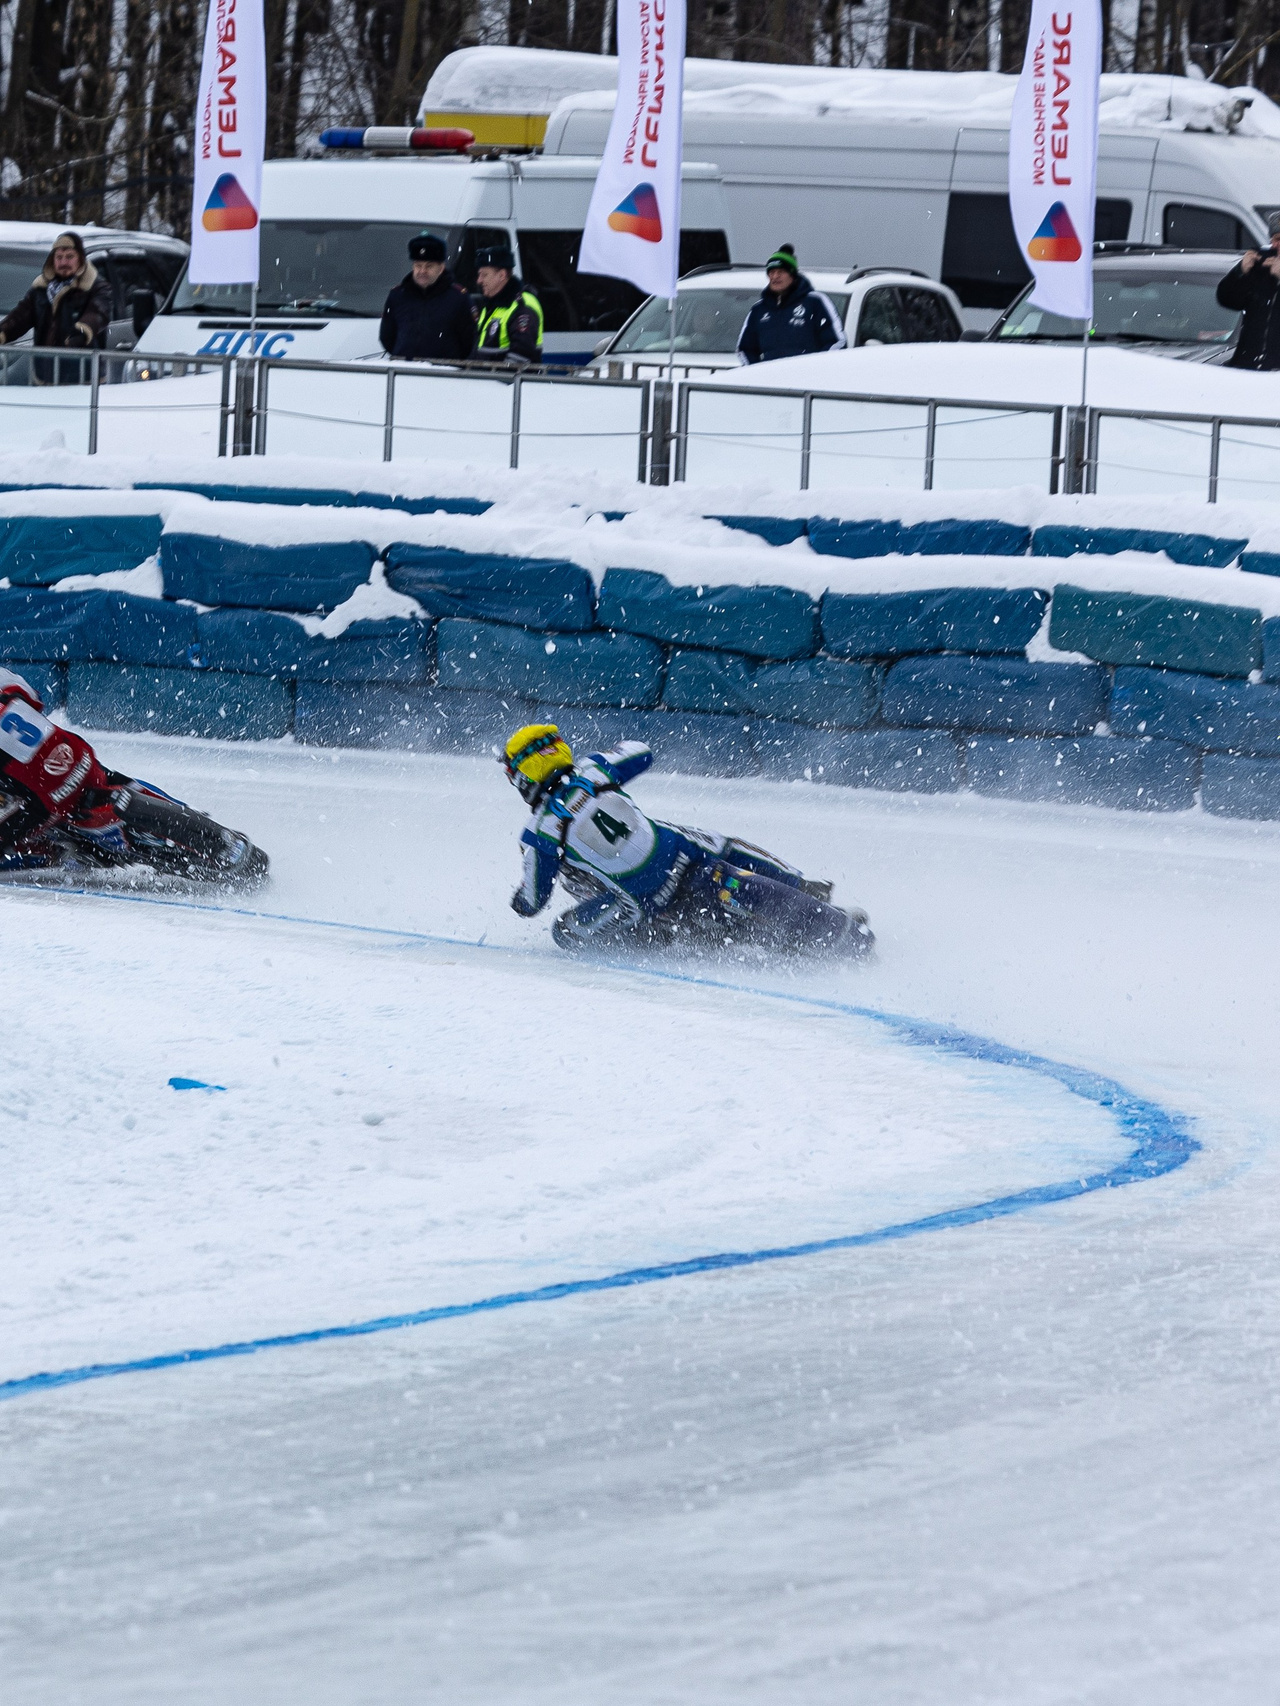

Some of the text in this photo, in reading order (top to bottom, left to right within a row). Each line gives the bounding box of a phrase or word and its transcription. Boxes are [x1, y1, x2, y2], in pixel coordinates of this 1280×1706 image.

[195, 330, 295, 359] ДПС
[0, 712, 43, 748] 3
[590, 806, 633, 846] 4
